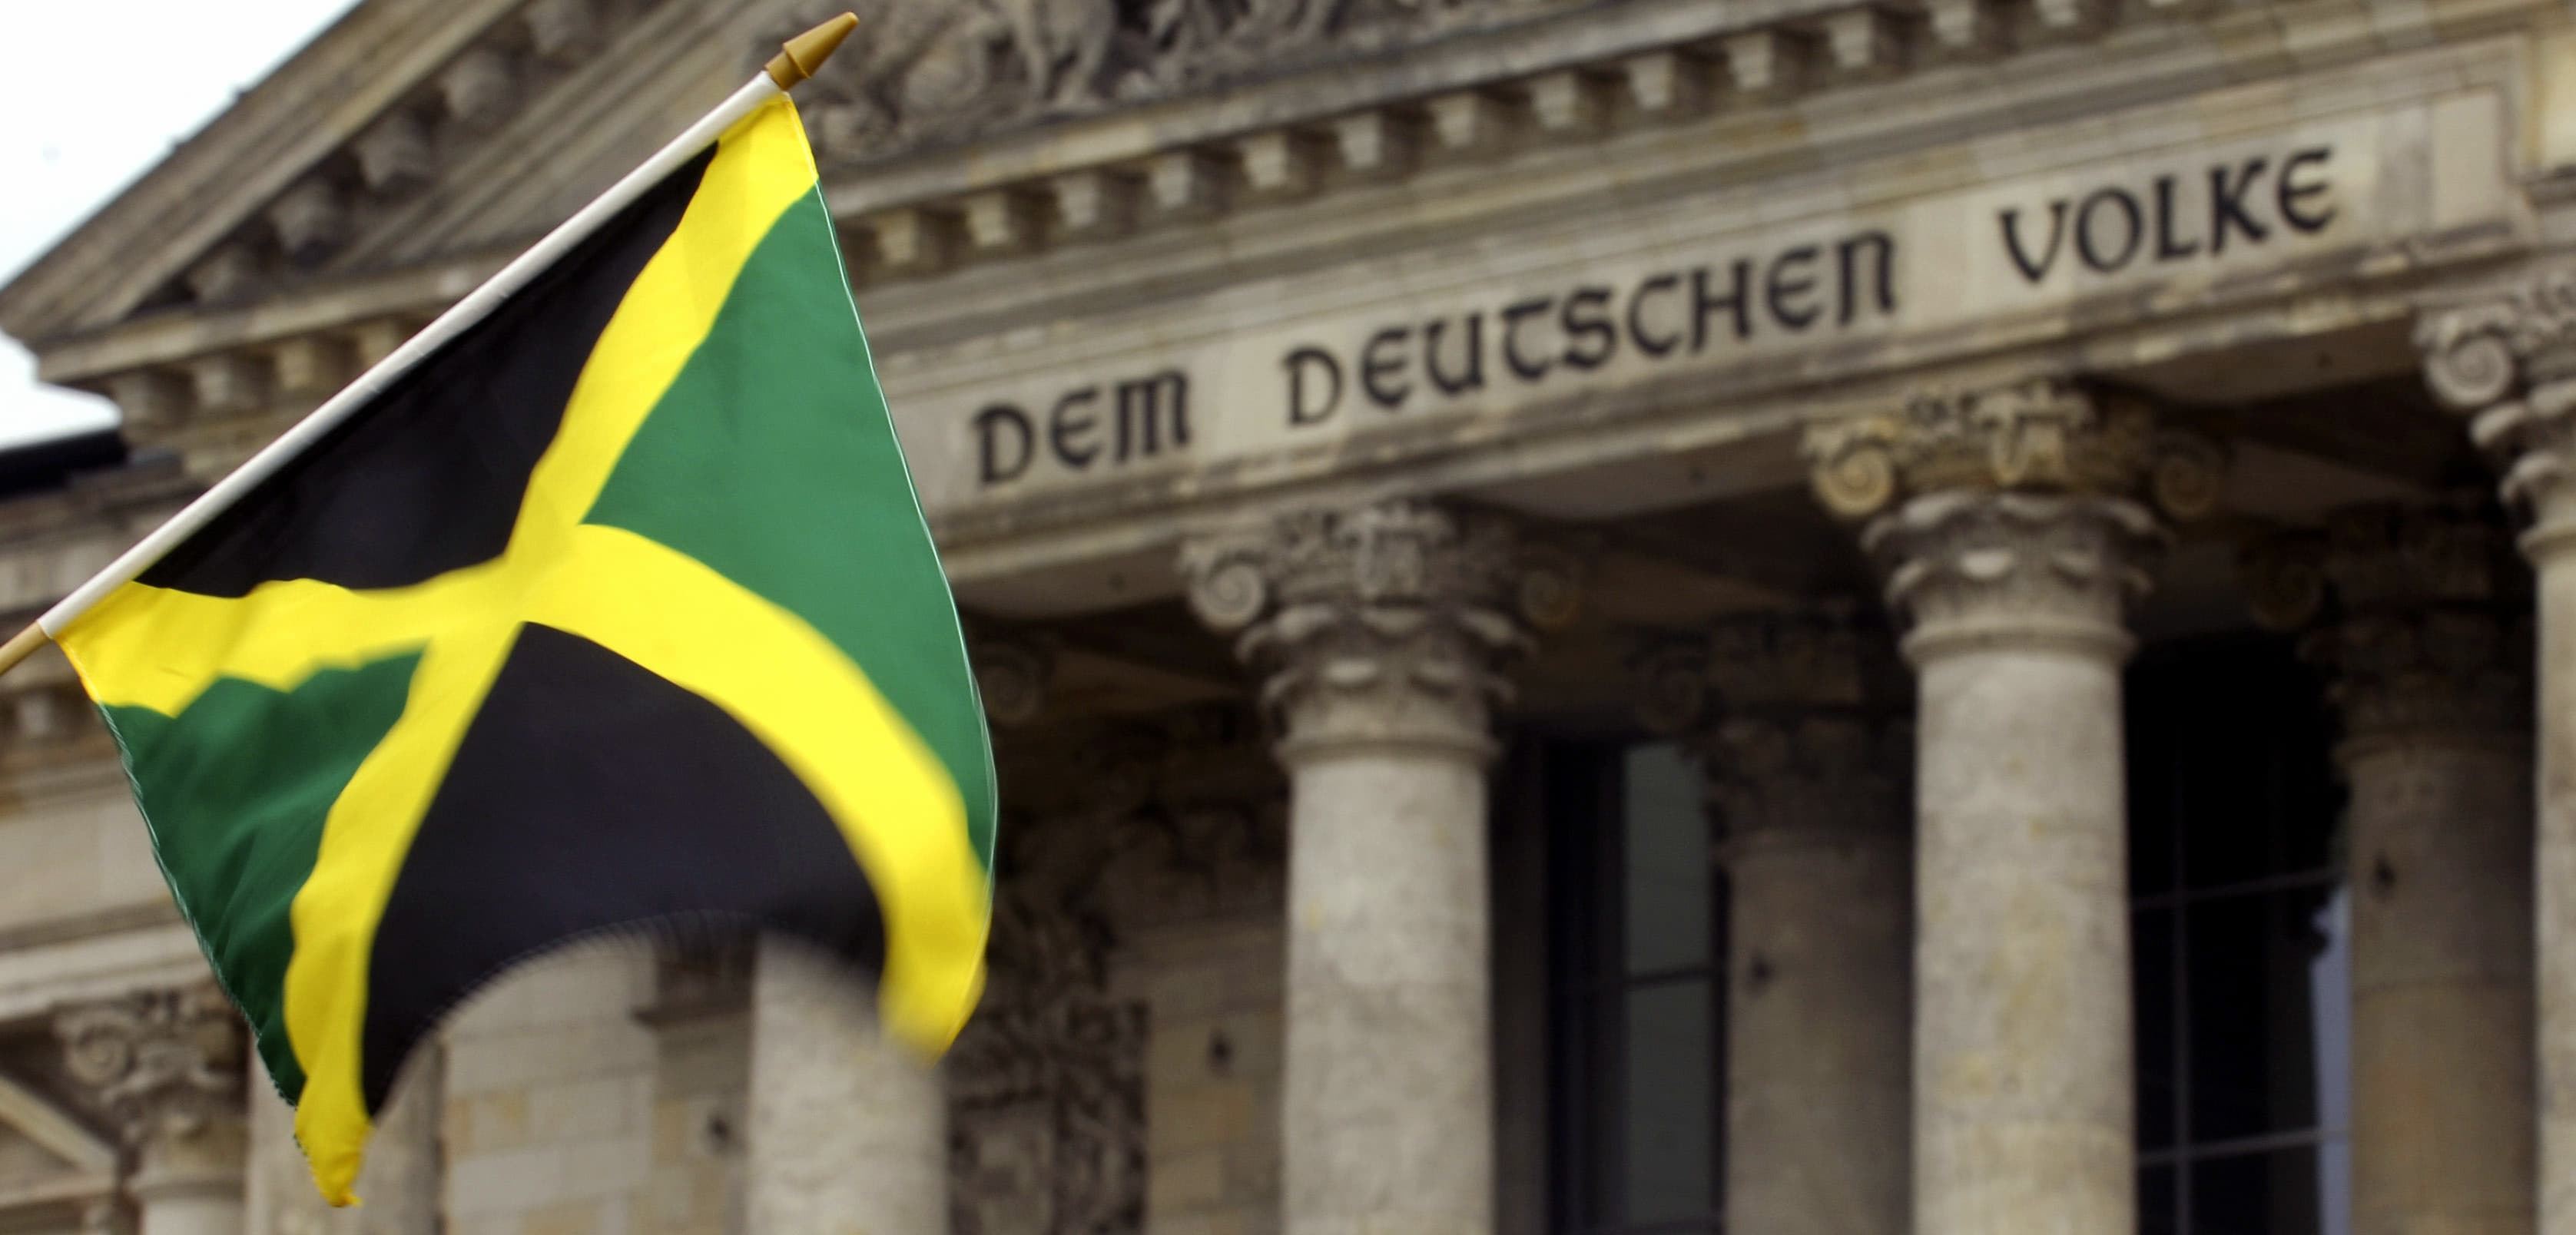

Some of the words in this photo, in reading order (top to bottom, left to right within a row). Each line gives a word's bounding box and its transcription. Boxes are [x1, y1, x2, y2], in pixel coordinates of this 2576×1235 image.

[972, 368, 1189, 485] DEM
[1282, 230, 1897, 426] DEUTSCHEN
[1997, 145, 2337, 284] VOLKE
